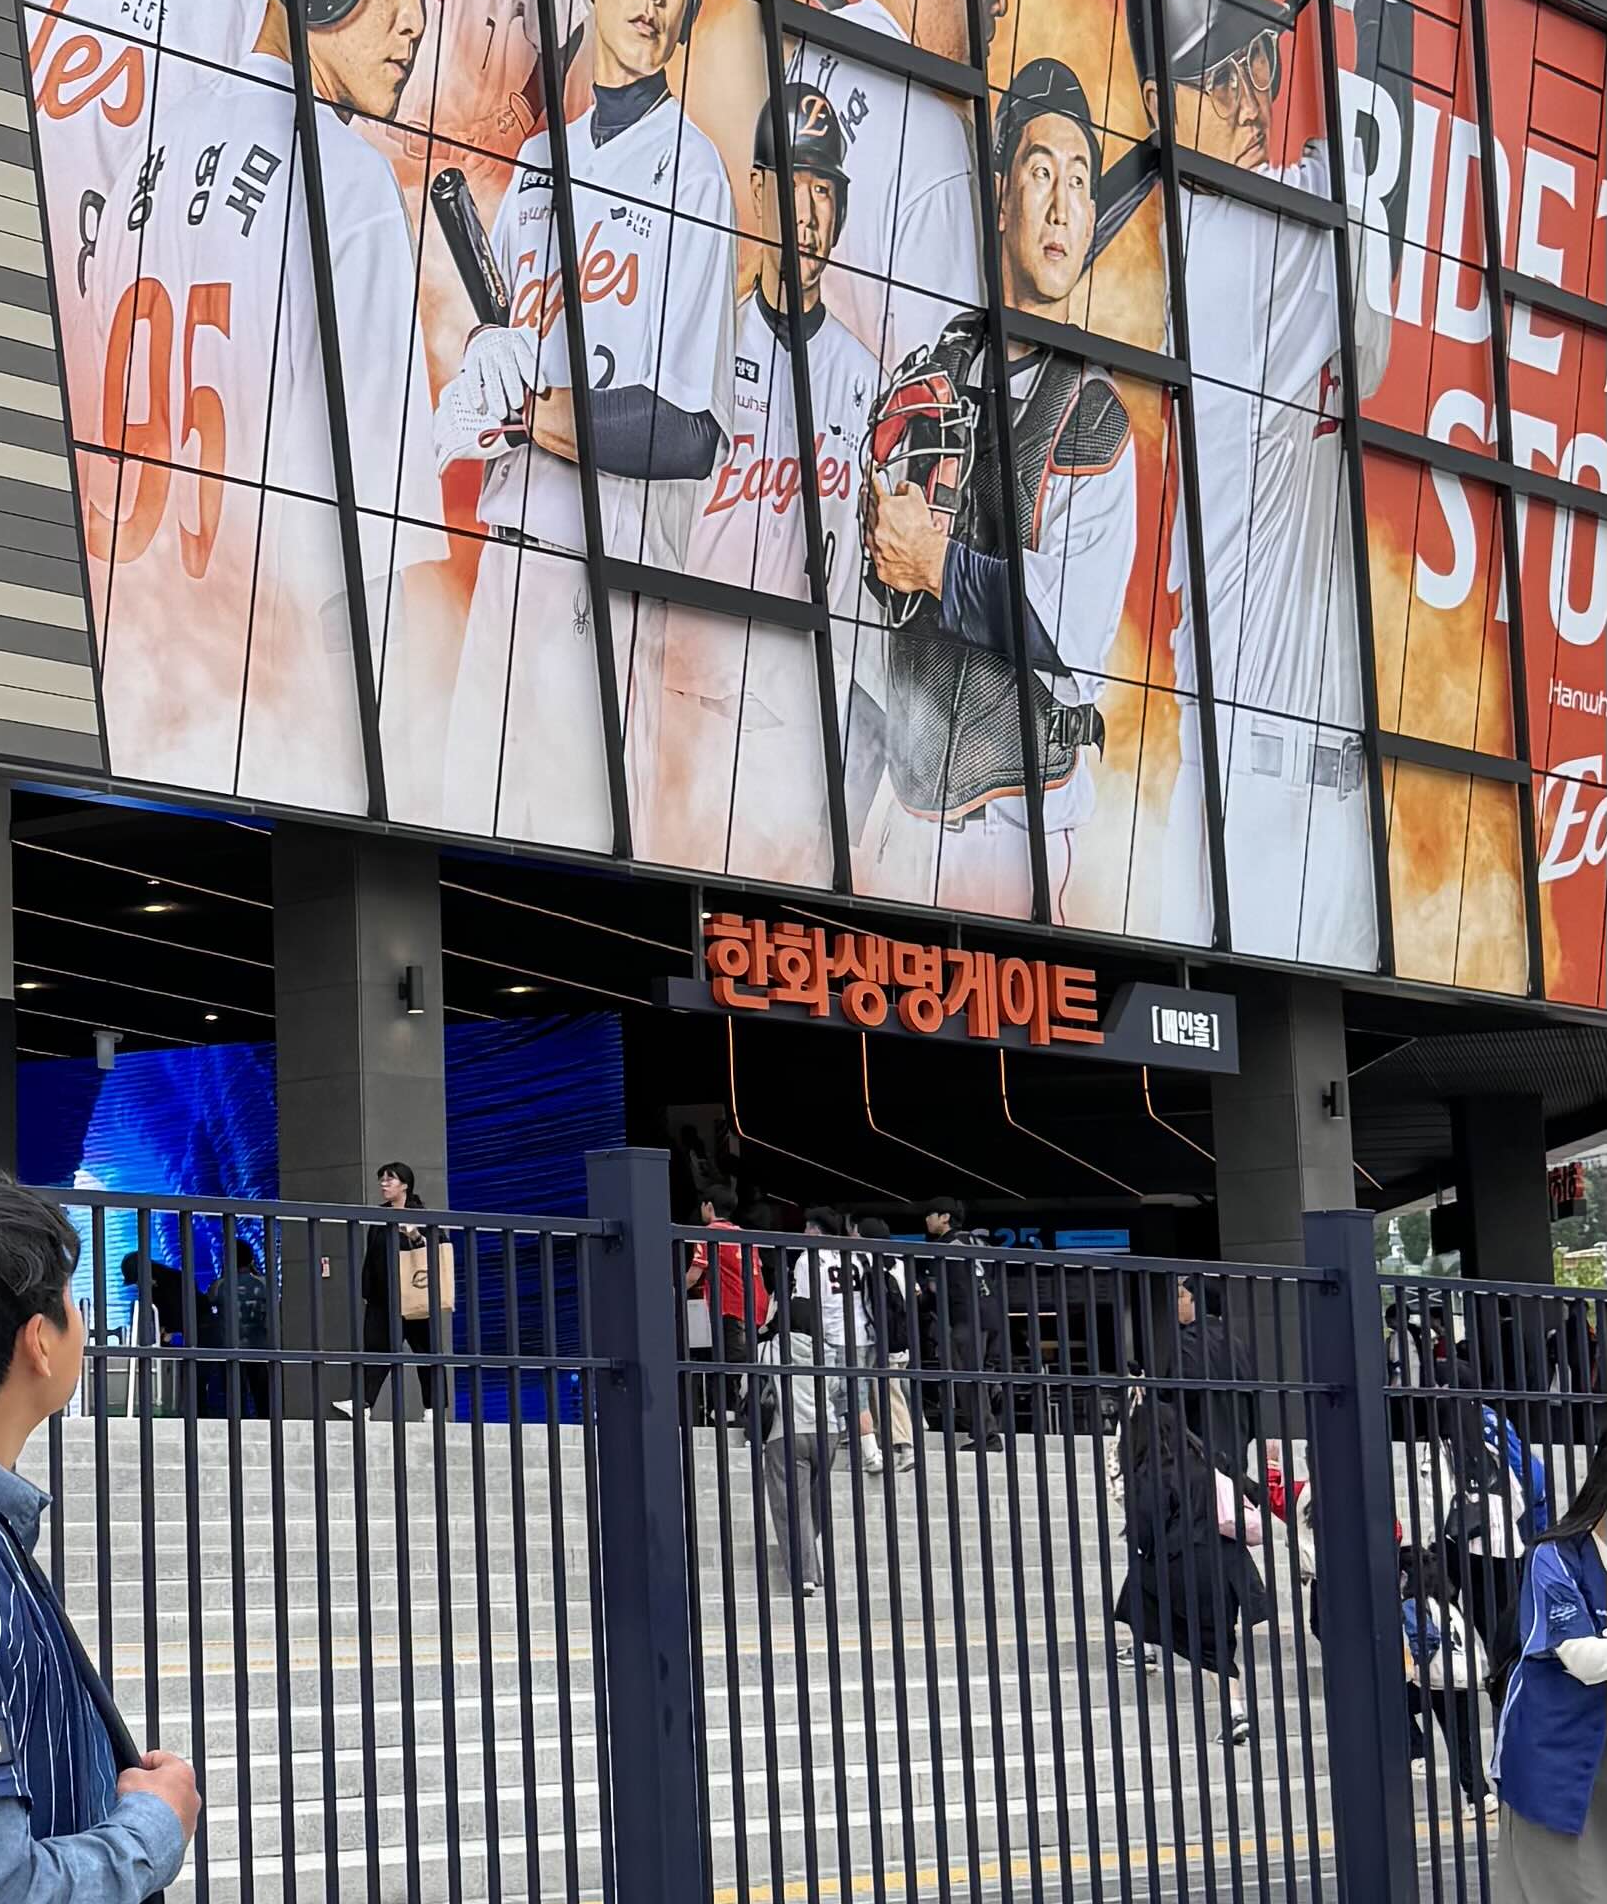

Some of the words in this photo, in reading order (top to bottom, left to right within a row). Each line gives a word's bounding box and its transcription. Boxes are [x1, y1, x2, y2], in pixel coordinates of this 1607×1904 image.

[121, 1, 154, 31] PLU
[1338, 67, 1576, 375] RIDE
[87, 278, 232, 580] 95
[704, 912, 1105, 1046] 한화생명게이트
